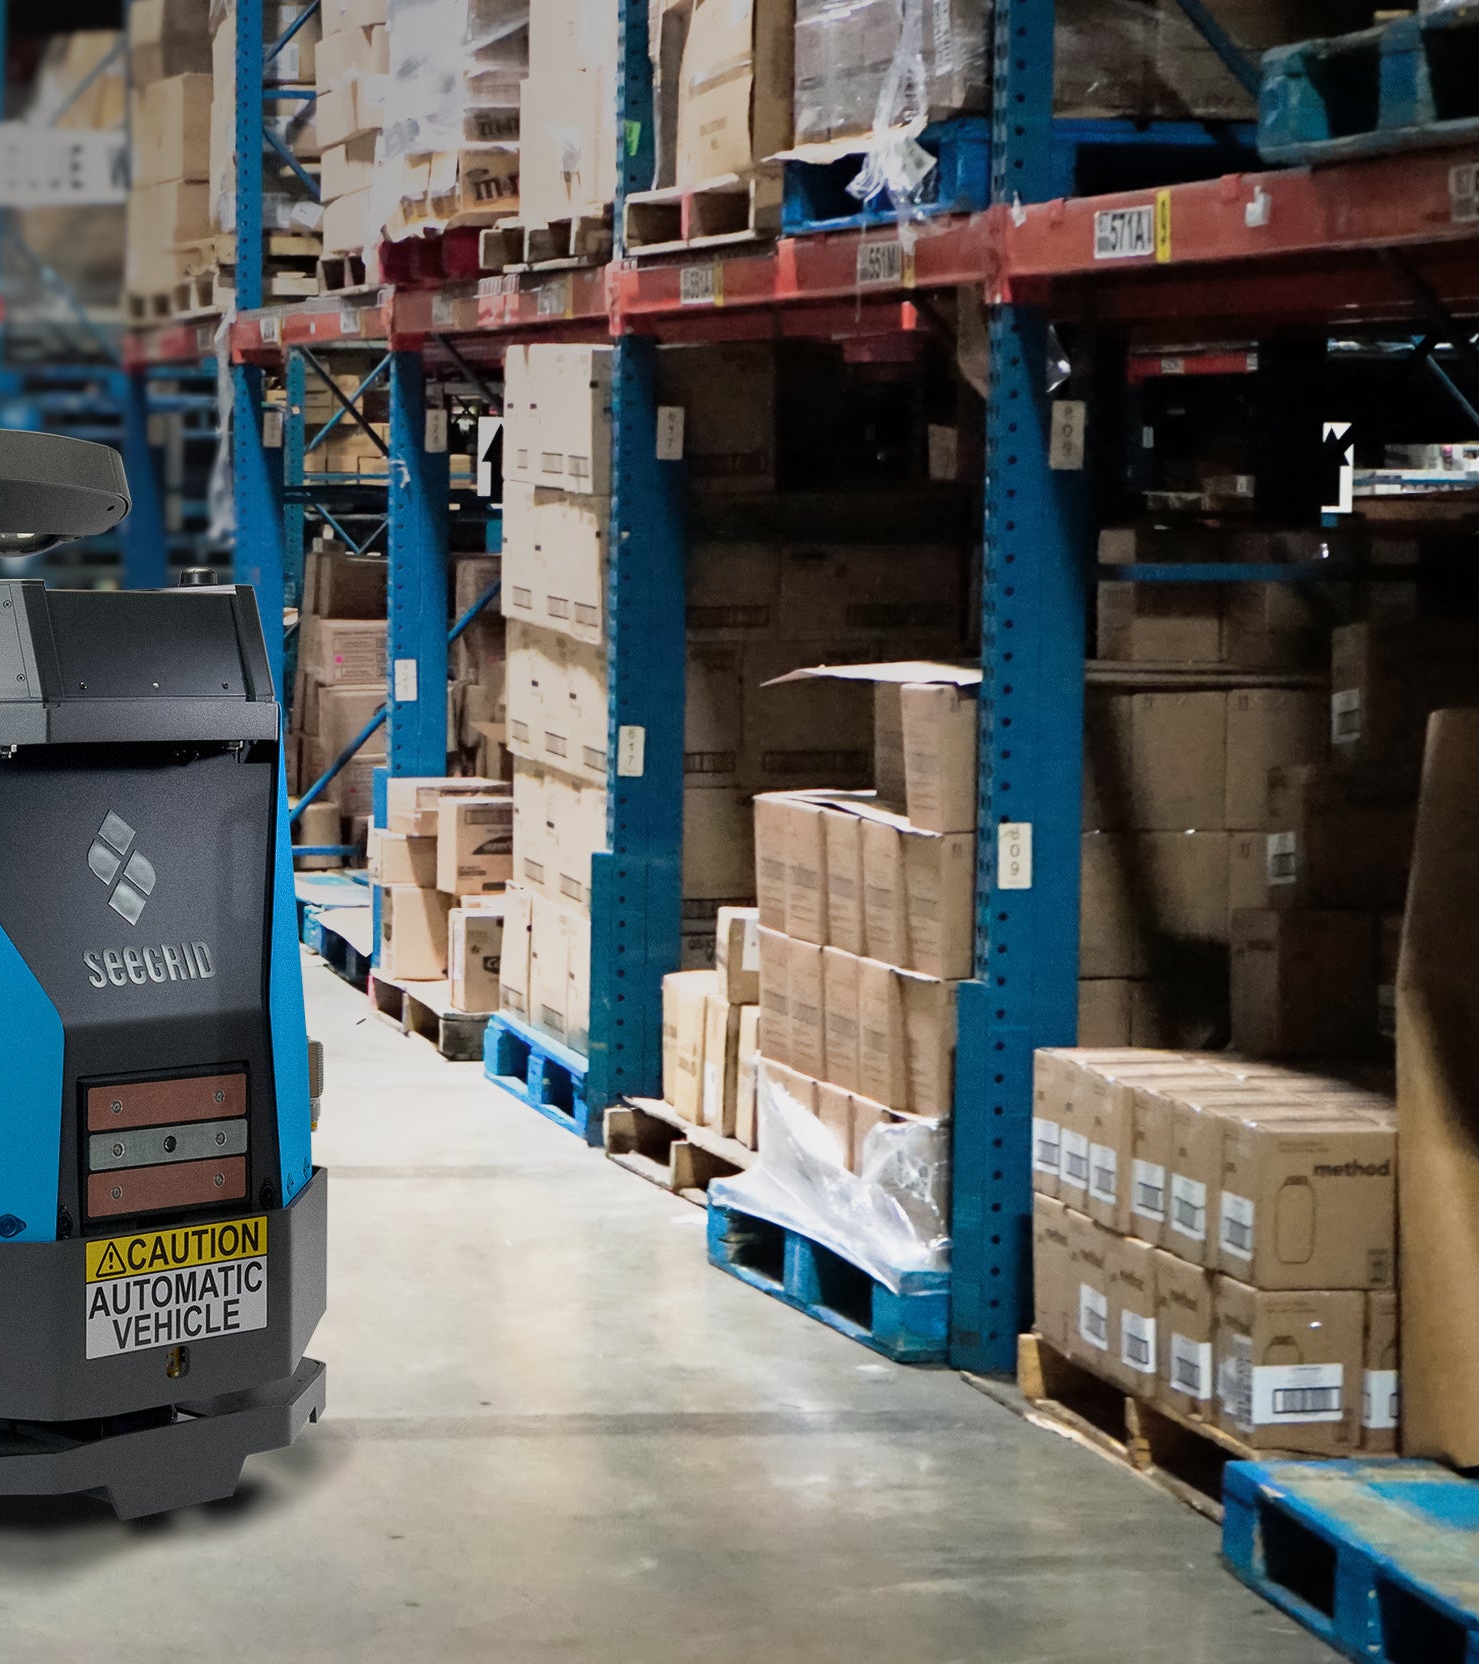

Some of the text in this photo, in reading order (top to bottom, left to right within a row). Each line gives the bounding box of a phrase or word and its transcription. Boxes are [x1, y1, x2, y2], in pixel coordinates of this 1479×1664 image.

[1314, 1158, 1390, 1176] method
[127, 1221, 259, 1271] CAUTION
[89, 1261, 263, 1319] AUTOMATIC
[112, 1298, 240, 1349] VEHICLE
